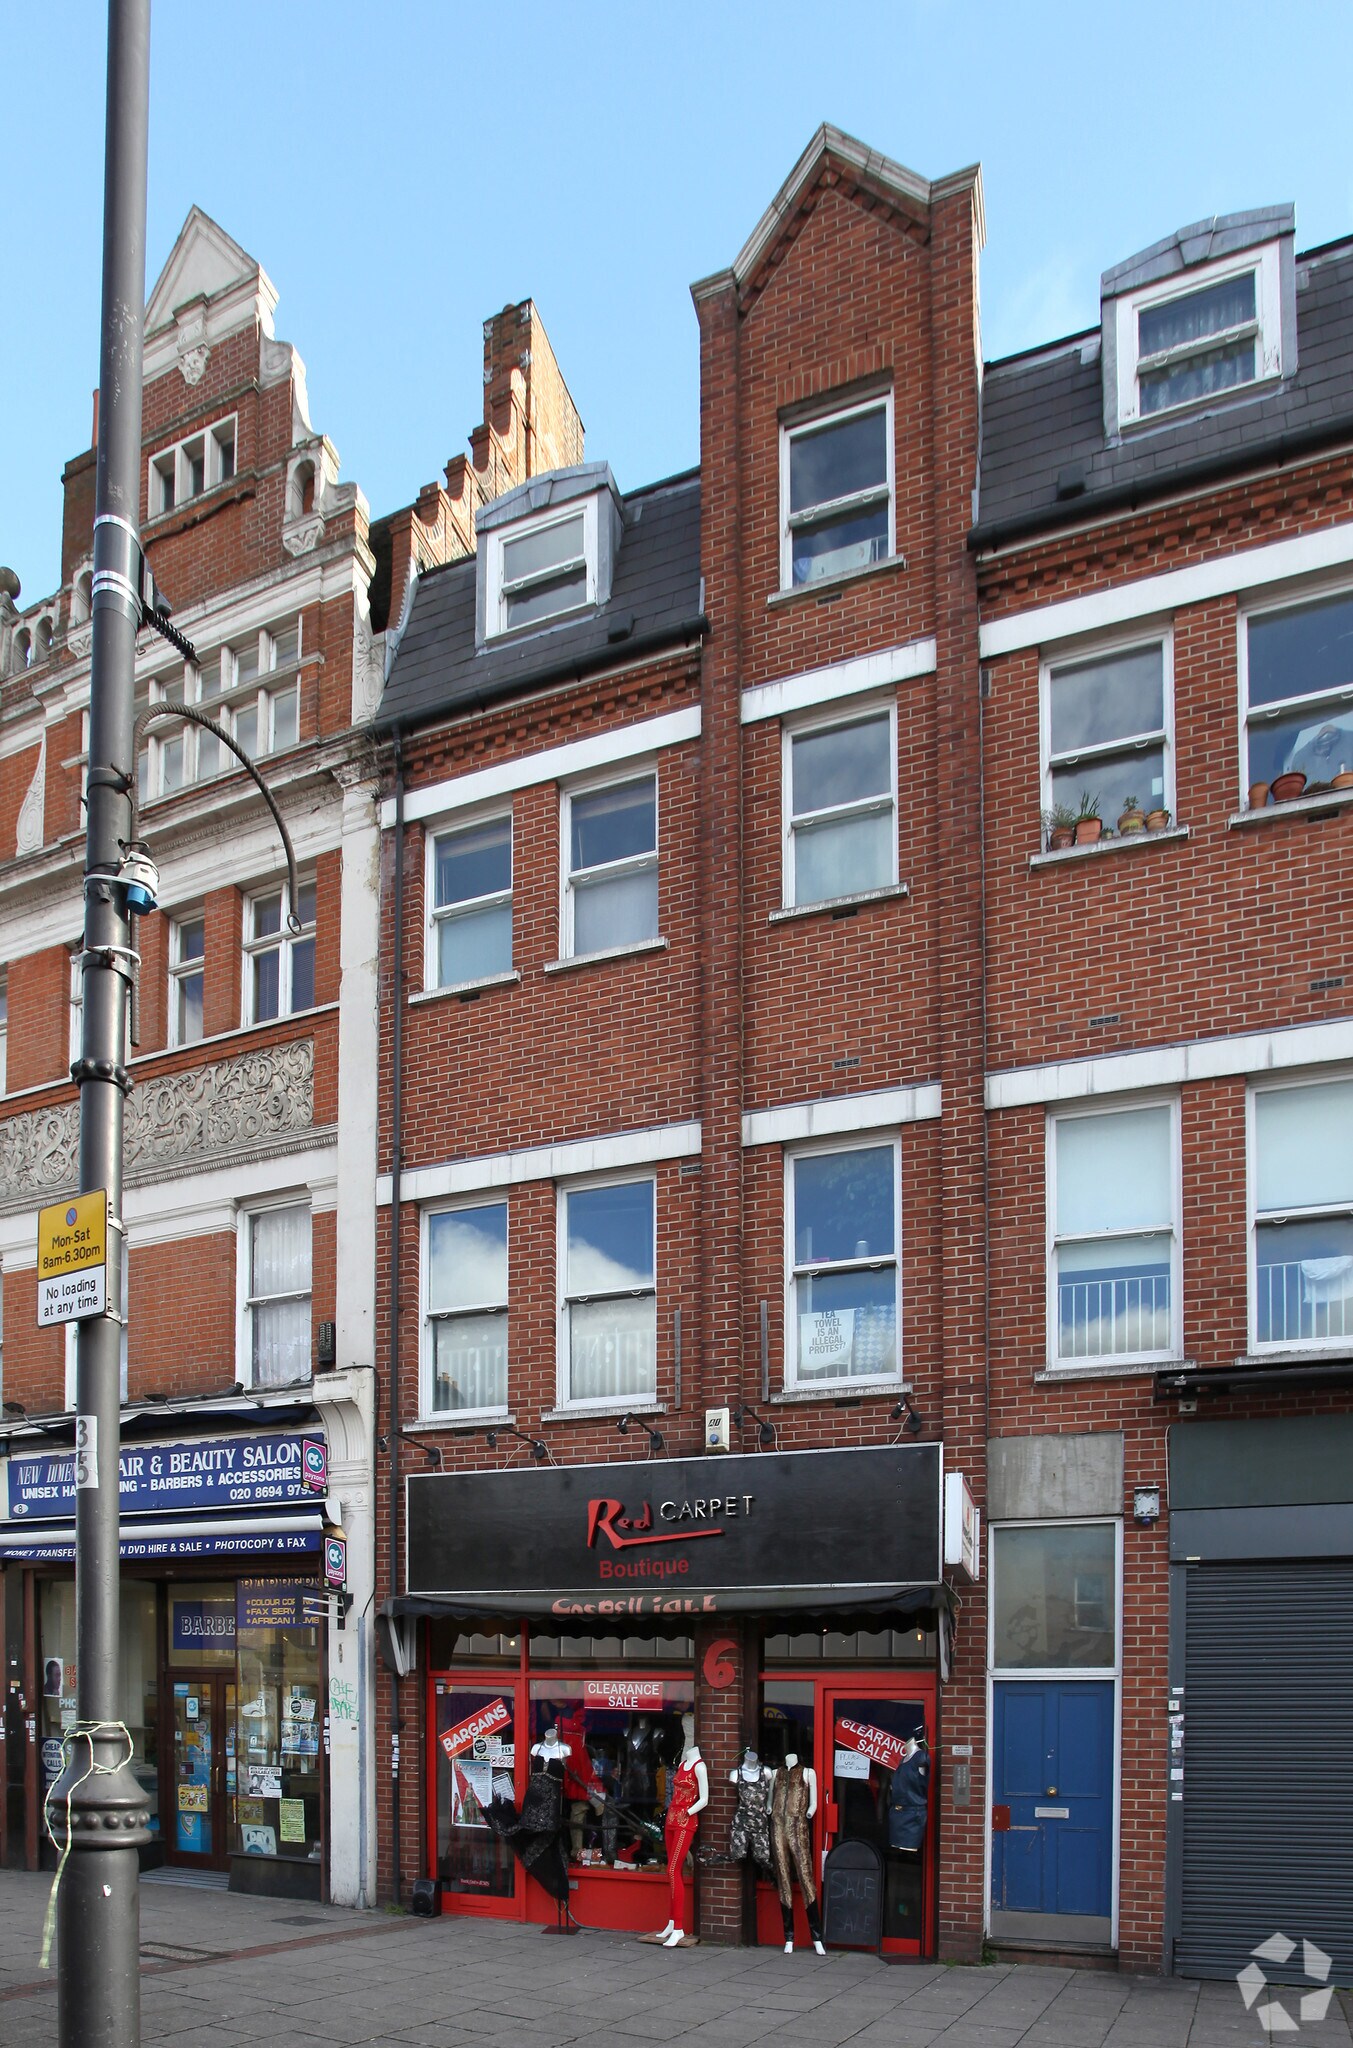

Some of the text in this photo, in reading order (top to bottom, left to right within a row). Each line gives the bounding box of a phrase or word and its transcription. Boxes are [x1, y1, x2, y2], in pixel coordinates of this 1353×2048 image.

[200, 1091, 288, 1149] 1889
[52, 1227, 91, 1250] Mon-Sat
[43, 1244, 100, 1269] 8am-6.30pm
[46, 1279, 96, 1300] No loading
[44, 1295, 98, 1317] at any time
[814, 1318, 842, 1328] TOWEL
[817, 1327, 839, 1337] IS AN
[812, 1335, 844, 1345] ILLEGAL
[119, 1442, 301, 1476] AIR & BEAUTY SALON
[17, 1465, 42, 1485] NEW
[119, 1480, 137, 1492] ING
[150, 1475, 203, 1490] BARBERS
[206, 1475, 214, 1486] &
[218, 1467, 300, 1485] ACCESSORIES
[304, 1471, 325, 1482] payzone
[22, 1484, 76, 1499] UNISEX HA
[230, 1487, 250, 1500] 020
[255, 1485, 283, 1498] 8694
[587, 1495, 753, 1549] Red CARPET
[4, 1549, 35, 1557] MONEY
[128, 1545, 146, 1554] DVD
[148, 1543, 167, 1553] HIRE
[170, 1543, 176, 1552] &
[179, 1541, 202, 1551] SALE
[214, 1538, 274, 1550] PHOTOCOPY
[277, 1538, 284, 1548] &
[287, 1537, 306, 1547] FAX
[600, 1558, 689, 1580] Boutique
[251, 1598, 280, 1606] COLOUR
[703, 1639, 737, 1690] 6
[588, 1683, 660, 1695] CLEARANCE
[608, 1696, 638, 1708] SALE
[443, 1704, 508, 1752] BARGAINS
[841, 1719, 906, 1757] CLEARANC
[501, 1746, 512, 1754] PEN
[857, 1738, 891, 1763] SALE
[831, 1871, 876, 1899] SALE
